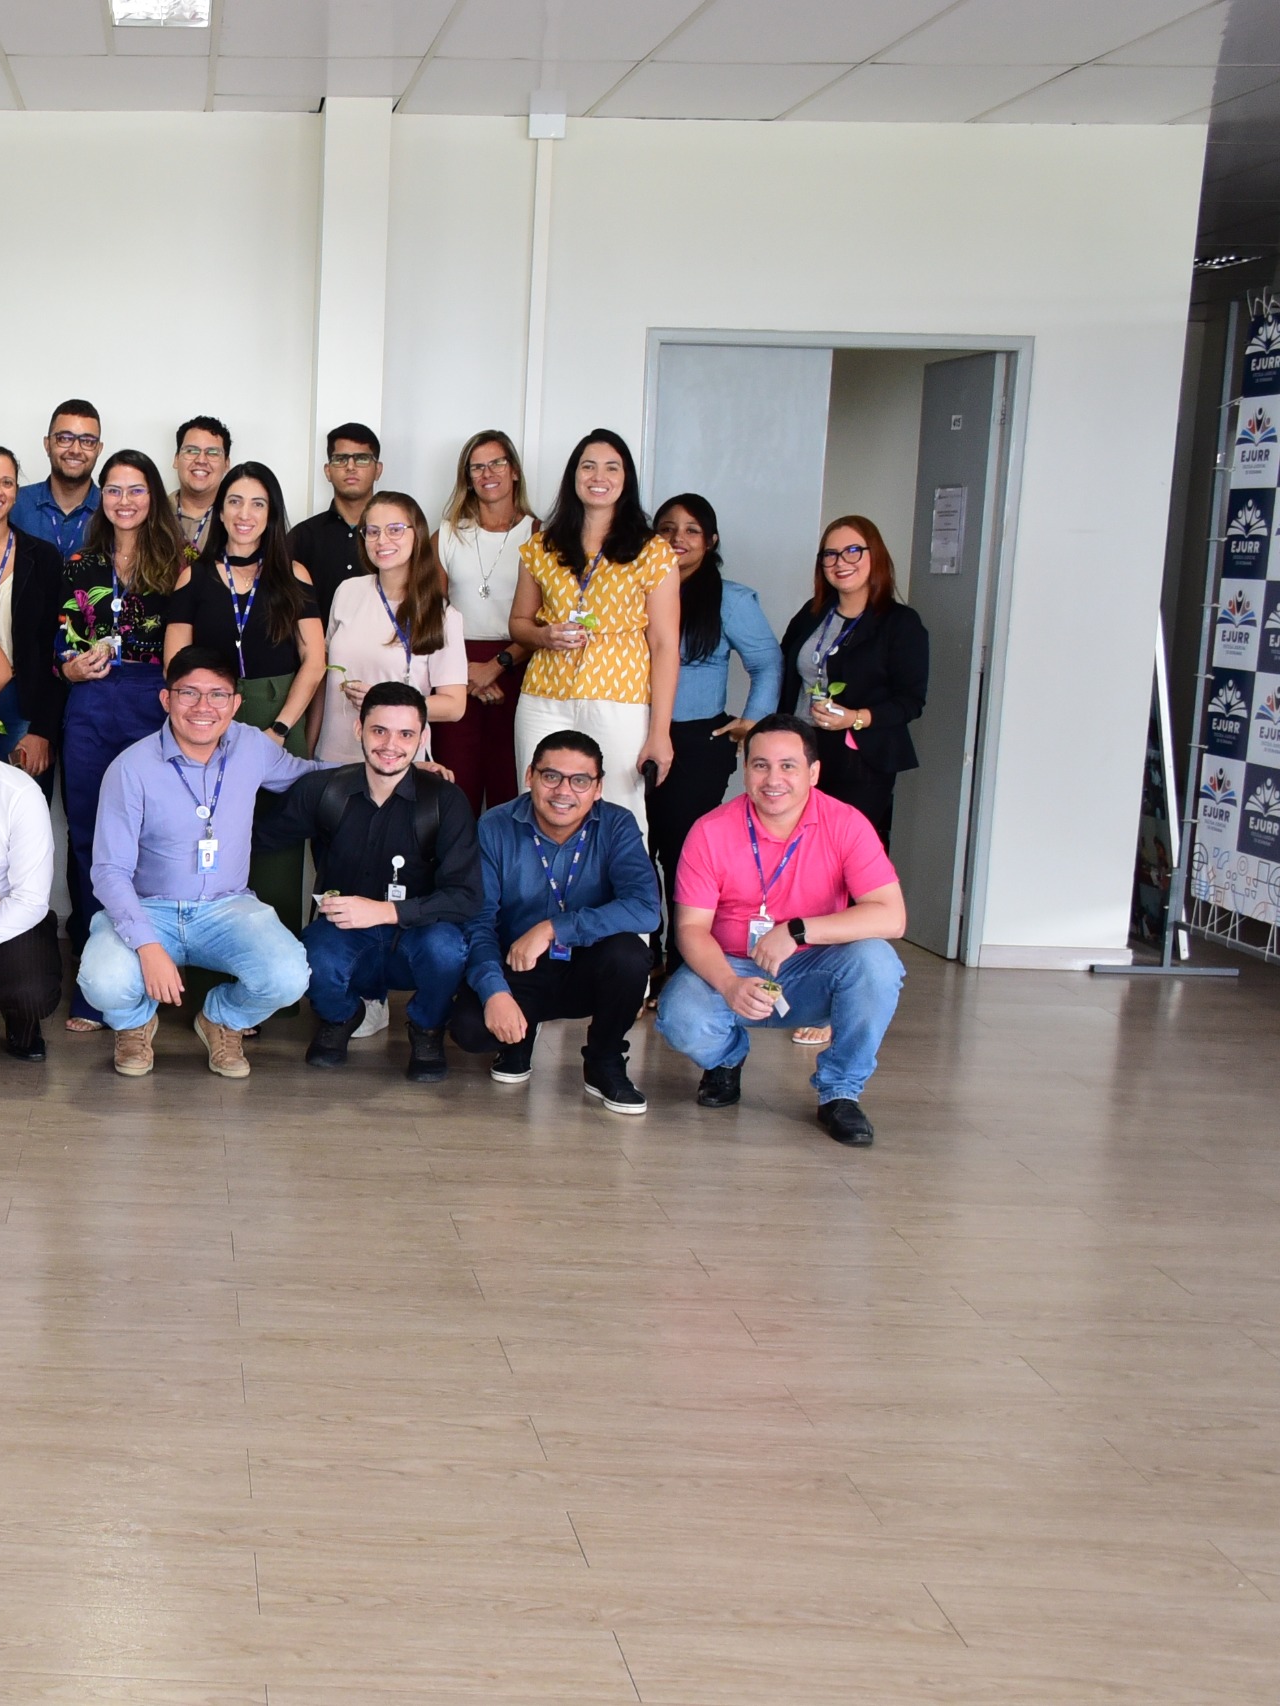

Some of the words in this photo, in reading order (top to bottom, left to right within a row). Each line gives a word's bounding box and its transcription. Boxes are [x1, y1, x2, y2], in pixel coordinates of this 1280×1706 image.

[1250, 356, 1280, 371] EJURR
[1240, 449, 1270, 462] EJURR
[1230, 540, 1260, 553] EJURR
[1221, 630, 1250, 644] EJURR
[1211, 717, 1241, 734] EJURR
[1202, 805, 1231, 823] EJURR
[1248, 816, 1280, 836] EJURR
